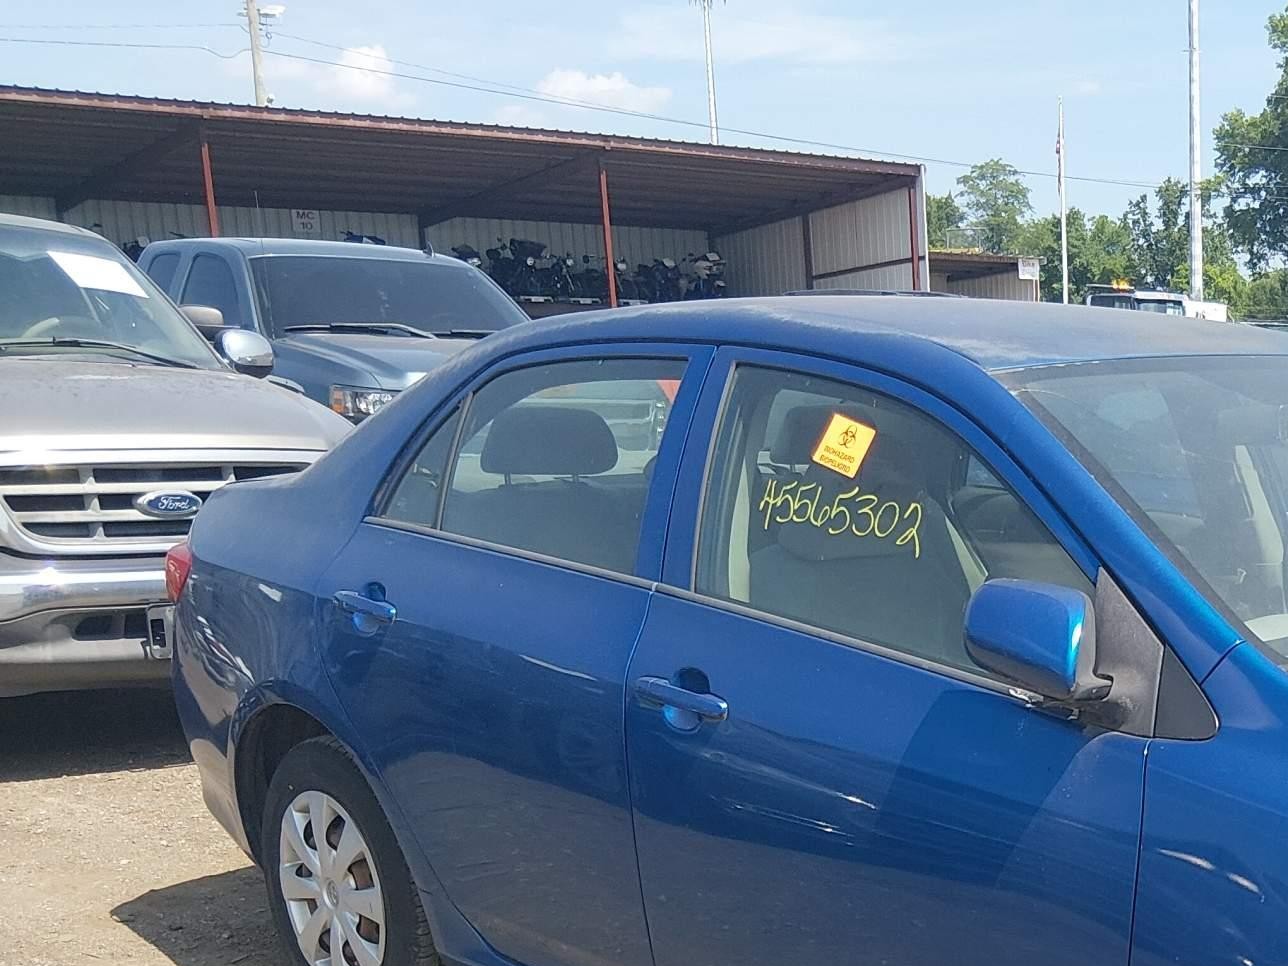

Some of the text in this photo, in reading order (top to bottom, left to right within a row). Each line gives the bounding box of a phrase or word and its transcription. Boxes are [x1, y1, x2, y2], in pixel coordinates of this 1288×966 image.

[296, 211, 315, 220] MC
[300, 221, 313, 230] 10
[158, 496, 190, 510] Ford
[759, 478, 922, 559] 45565302
